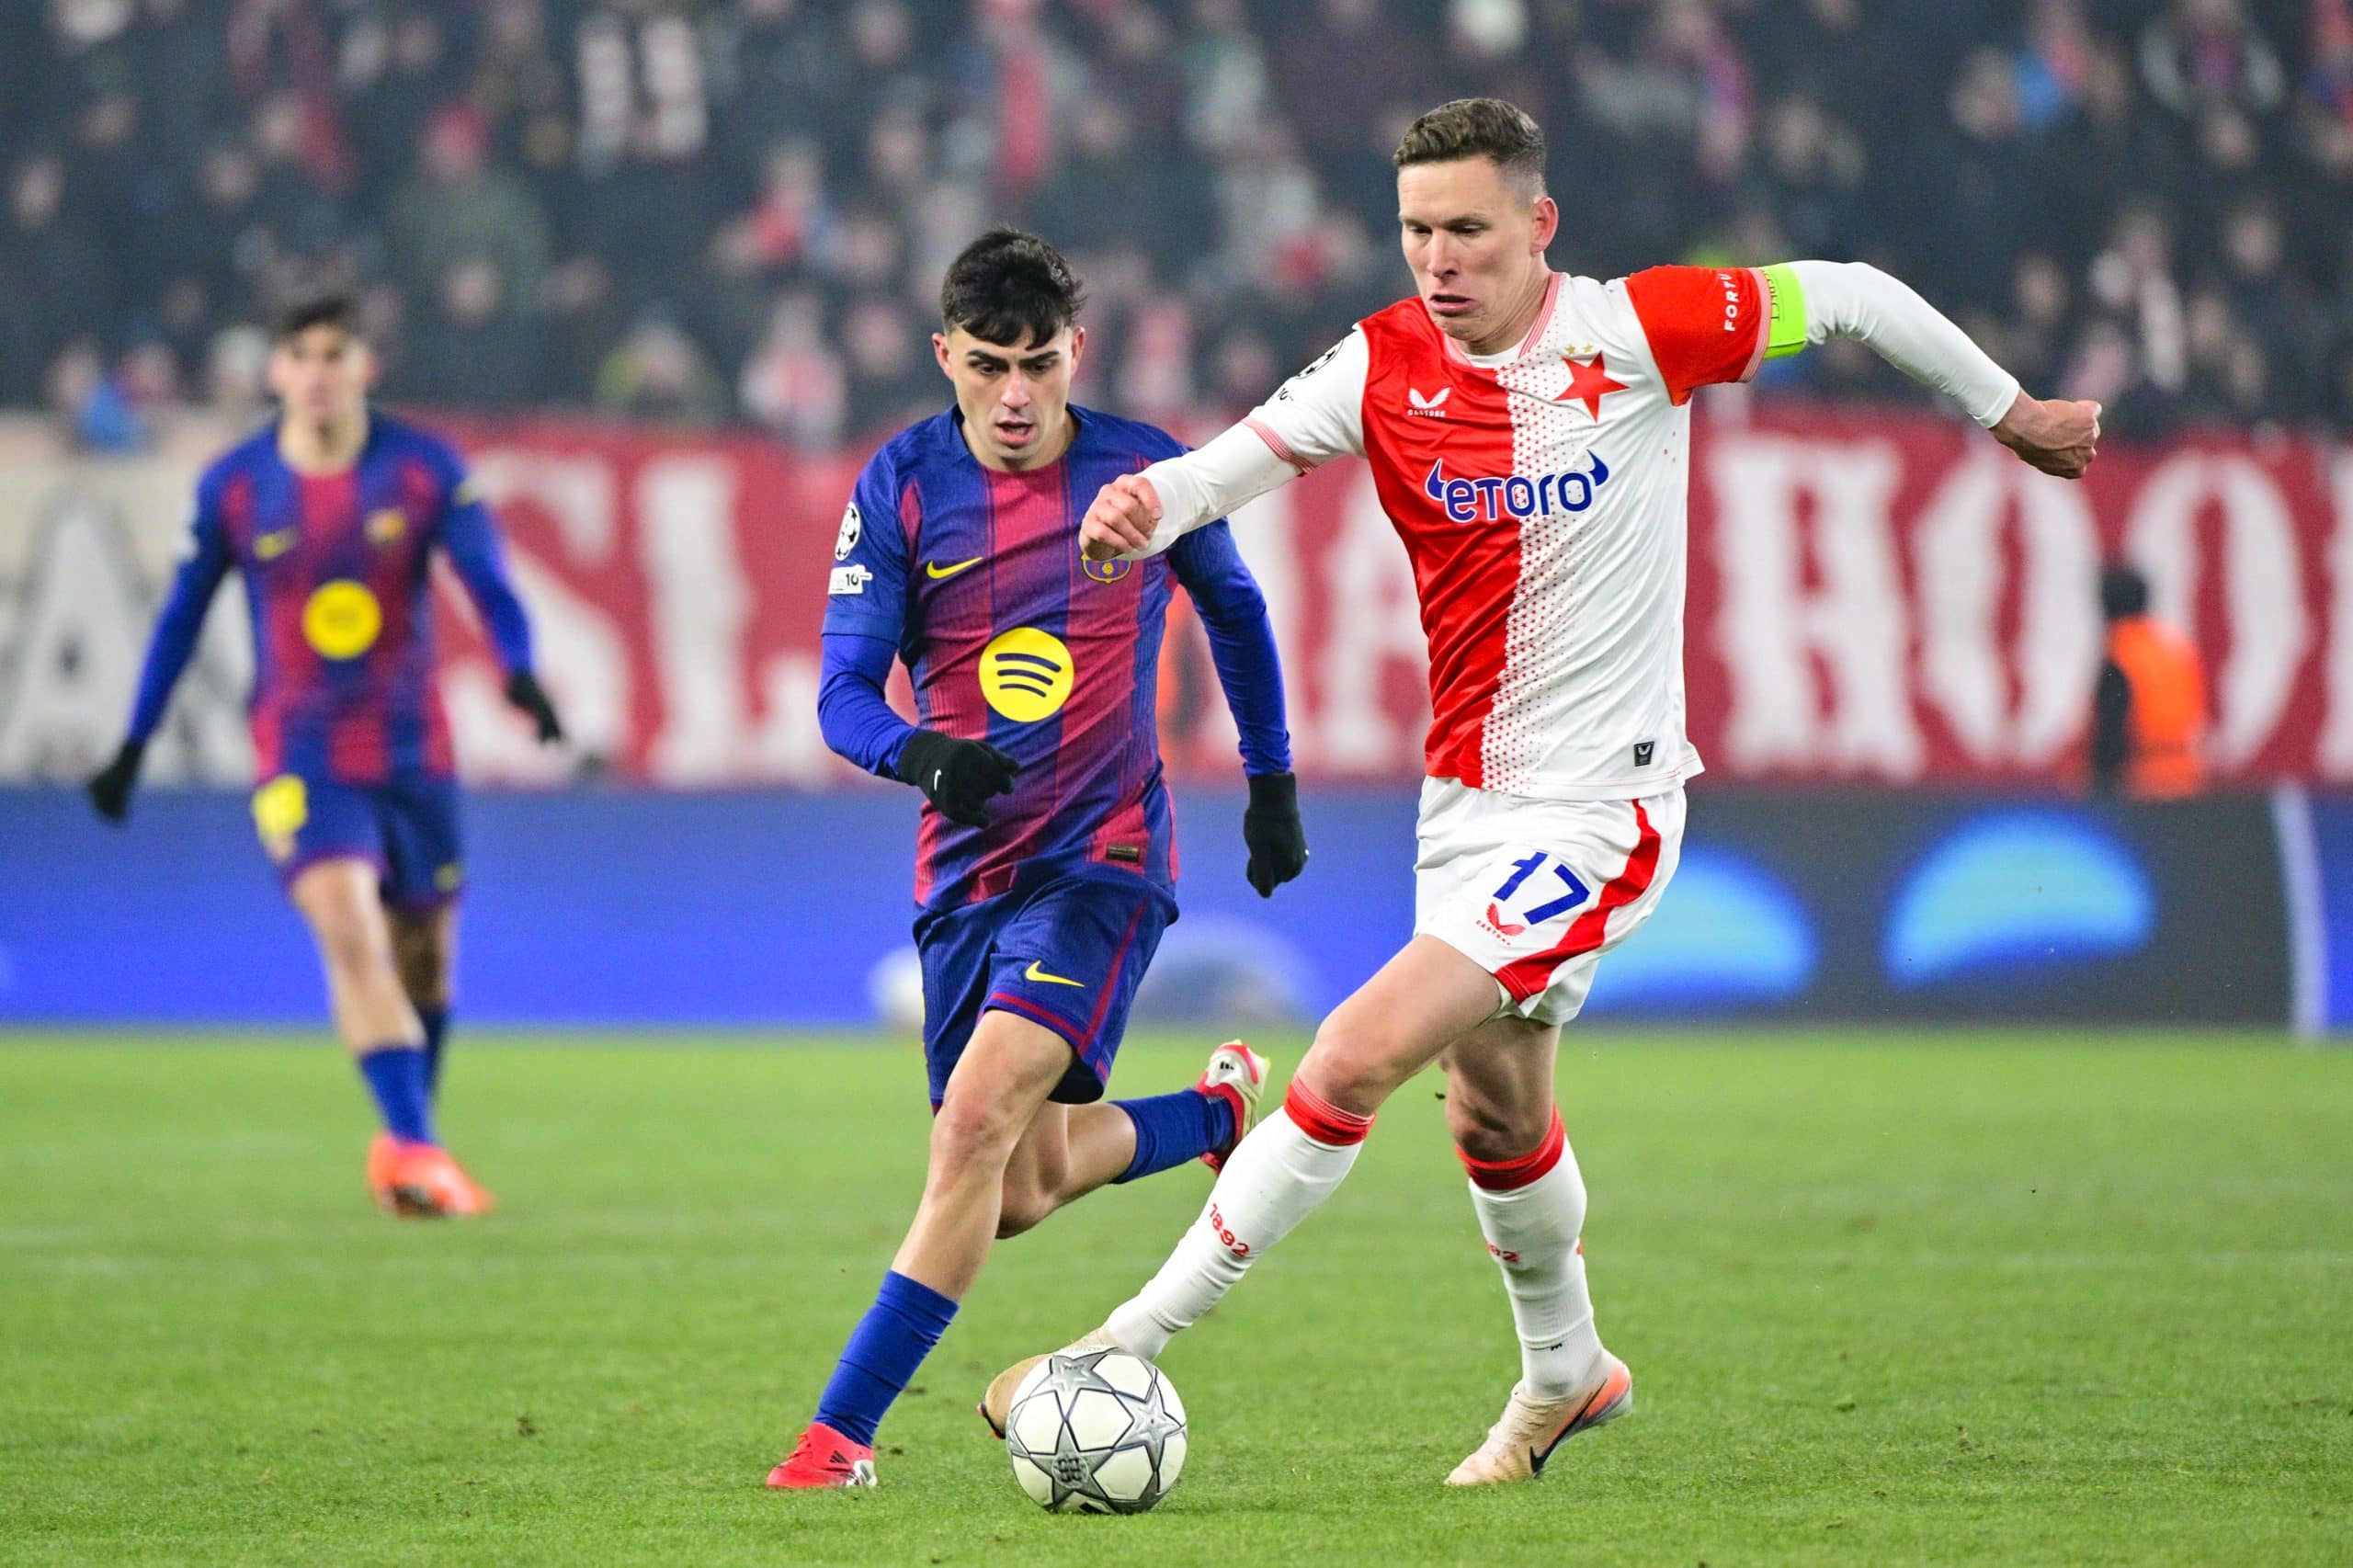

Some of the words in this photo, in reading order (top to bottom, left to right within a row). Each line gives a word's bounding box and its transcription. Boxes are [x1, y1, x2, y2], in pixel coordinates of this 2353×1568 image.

[1708, 432, 2353, 783] HOO
[1493, 851, 1590, 926] 17
[1209, 1202, 1250, 1257] 1892
